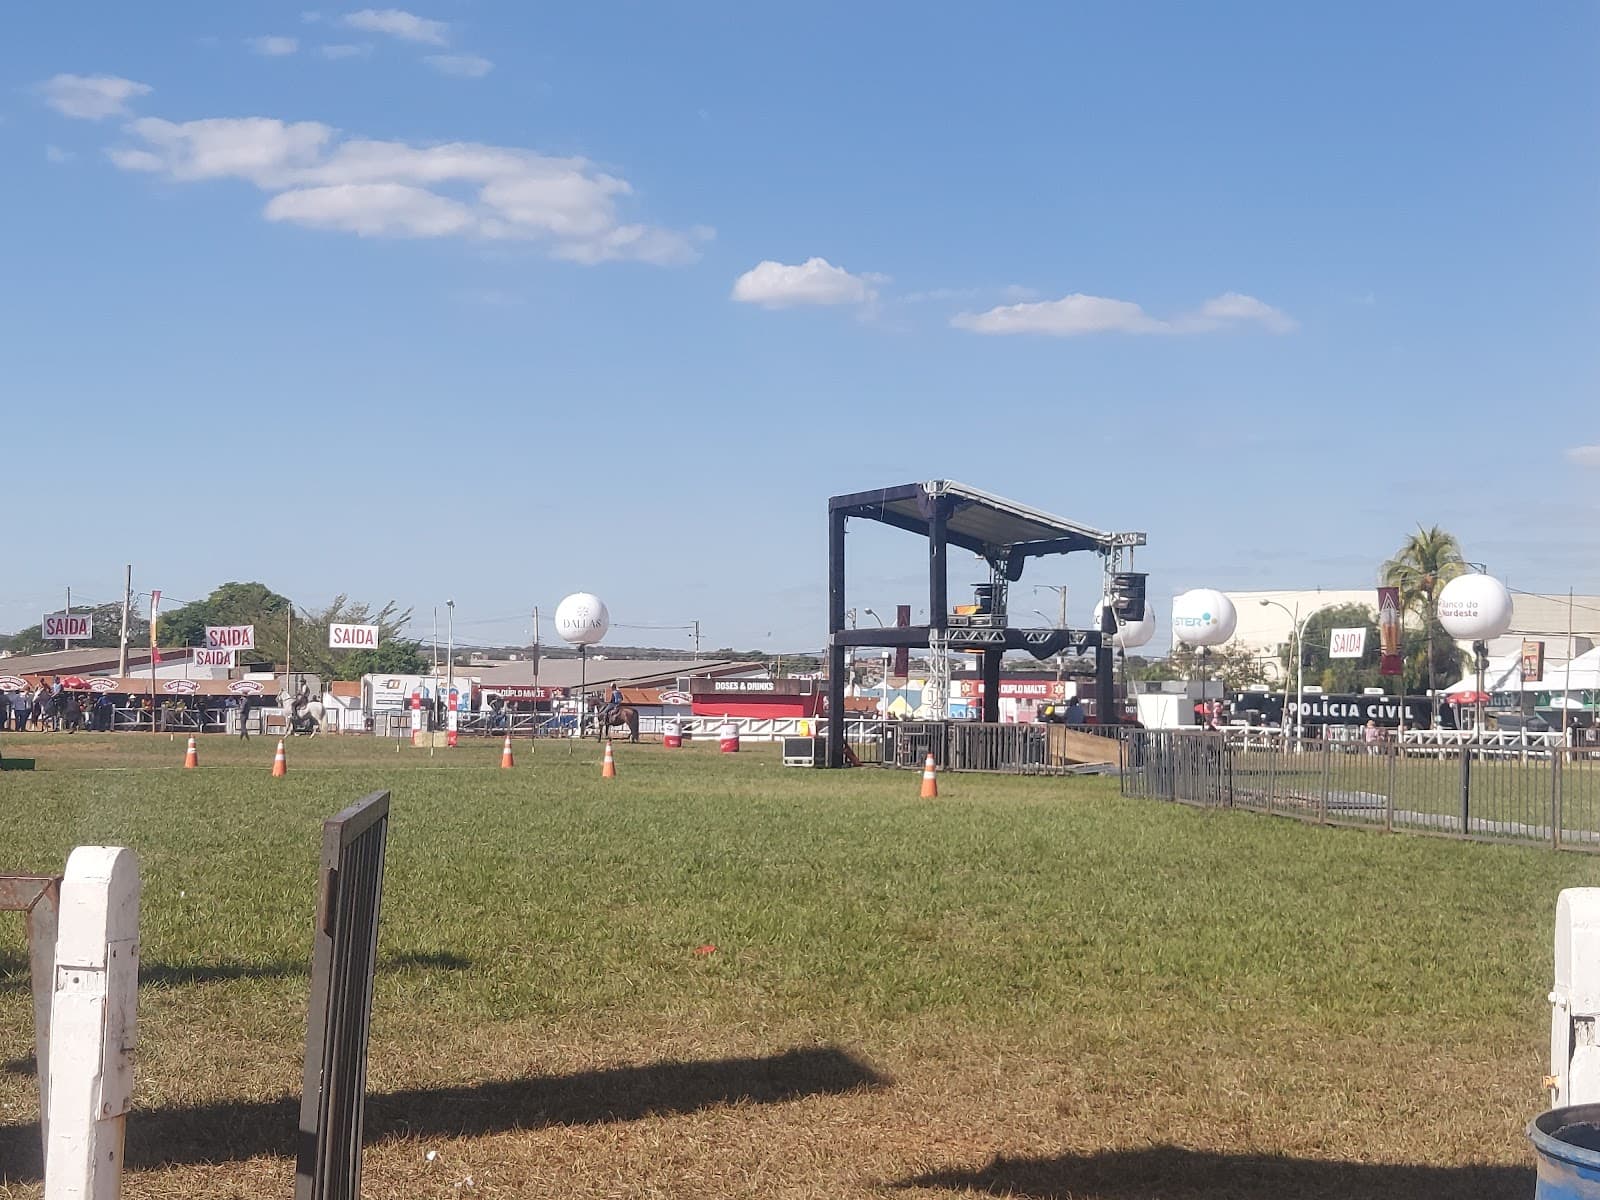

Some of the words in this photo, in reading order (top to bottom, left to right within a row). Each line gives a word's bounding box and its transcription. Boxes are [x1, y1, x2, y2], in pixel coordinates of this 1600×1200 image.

[562, 618, 602, 629] DALLAS
[715, 682, 739, 690] DOSES
[747, 682, 774, 690] DRINKS
[1000, 684, 1023, 694] DUPLO
[1023, 684, 1047, 694] MALTE
[1288, 701, 1360, 718] POLÍCIA
[1366, 704, 1414, 719] CIVIL
